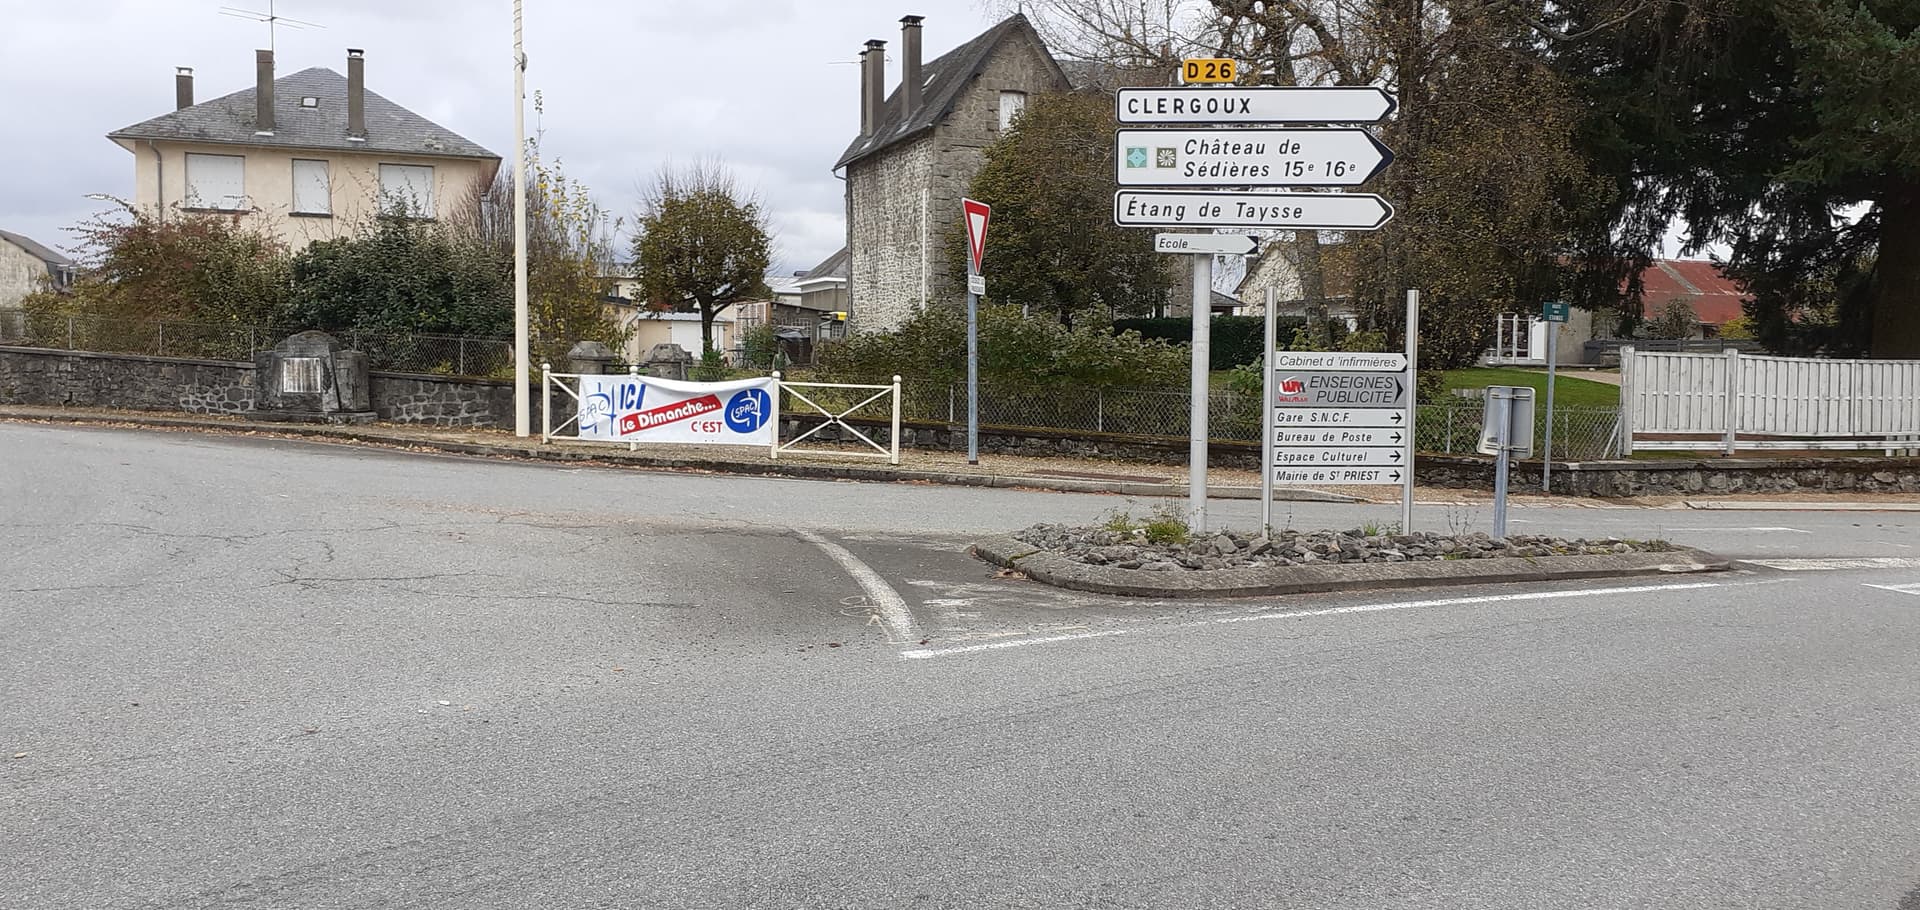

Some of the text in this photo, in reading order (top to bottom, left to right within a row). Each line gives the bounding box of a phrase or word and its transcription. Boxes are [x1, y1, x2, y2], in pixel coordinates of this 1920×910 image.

[1187, 62, 1231, 78] D 26
[1127, 97, 1251, 114] CLERGOUX
[1185, 139, 1301, 155] Château de
[1184, 160, 1270, 177] Sédières
[1126, 197, 1303, 221] Étang de Taysse
[1159, 238, 1188, 249] Ecole
[1279, 355, 1323, 367] Cabinet
[1309, 375, 1394, 390] ENSEIGNES
[620, 383, 646, 410] ICI
[1316, 390, 1393, 404] PUBLICITE
[734, 403, 755, 418] SPAC
[1277, 412, 1352, 423] Gare S.N.C.F.
[690, 420, 723, 433] C'EST
[1276, 431, 1372, 442] Bureau de Poste
[1276, 451, 1368, 464] Espace Culturel
[1276, 470, 1308, 481] Mairie
[1312, 471, 1325, 481] de
[1343, 470, 1380, 481] PRIEST
